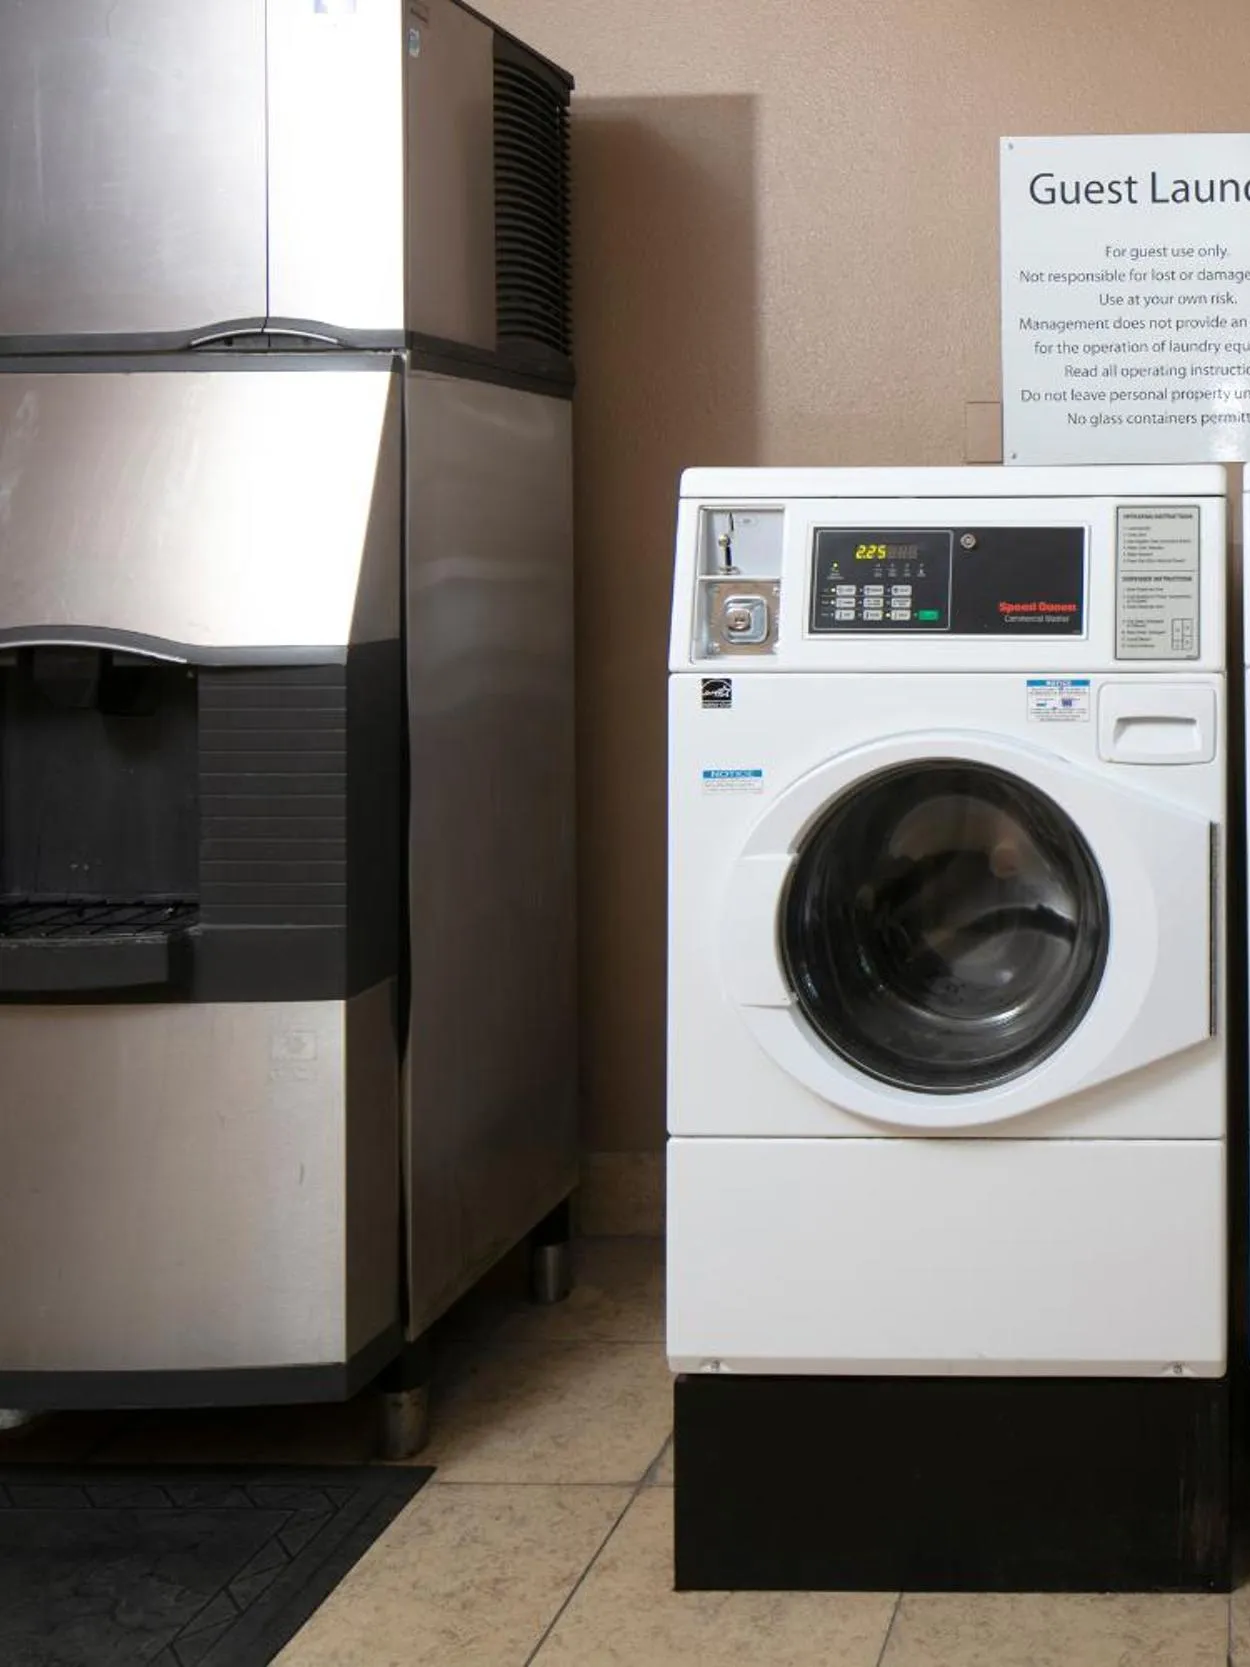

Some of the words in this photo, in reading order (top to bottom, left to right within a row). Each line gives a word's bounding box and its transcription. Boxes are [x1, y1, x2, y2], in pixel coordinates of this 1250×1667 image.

[1029, 173, 1139, 206] Guest
[1105, 246, 1126, 258] For
[1130, 246, 1168, 260] guest
[1172, 247, 1194, 258] use
[1198, 245, 1230, 259] only.
[1019, 270, 1044, 283] Not
[1048, 270, 1125, 286] responsible
[1129, 269, 1148, 282] for
[1151, 269, 1175, 282] lost
[1179, 271, 1193, 282] or
[1099, 294, 1124, 306] Use
[1127, 295, 1140, 306] at
[1144, 295, 1174, 310] your
[1178, 295, 1207, 305] own
[1211, 292, 1238, 305] risk.
[1019, 318, 1109, 333] Management
[1113, 317, 1145, 330] does
[1149, 318, 1172, 330] not
[1176, 316, 1227, 332] provide
[1231, 318, 1248, 329] an
[1034, 341, 1053, 355] for
[1057, 341, 1079, 355] the
[1083, 341, 1148, 356] operation
[1152, 340, 1165, 354] of
[1168, 340, 1221, 356] laundry
[1064, 365, 1098, 378] Read
[1101, 365, 1117, 378] all
[1121, 365, 1186, 380] operating
[1021, 389, 1041, 402] Do
[1044, 389, 1067, 402] not
[1071, 389, 1106, 402] leave
[1110, 388, 1168, 403] personal
[1171, 388, 1230, 403] property
[1067, 413, 1087, 425] No
[1090, 412, 1122, 428] glass
[1126, 412, 1197, 425] containers
[999, 602, 1037, 614] Speed
